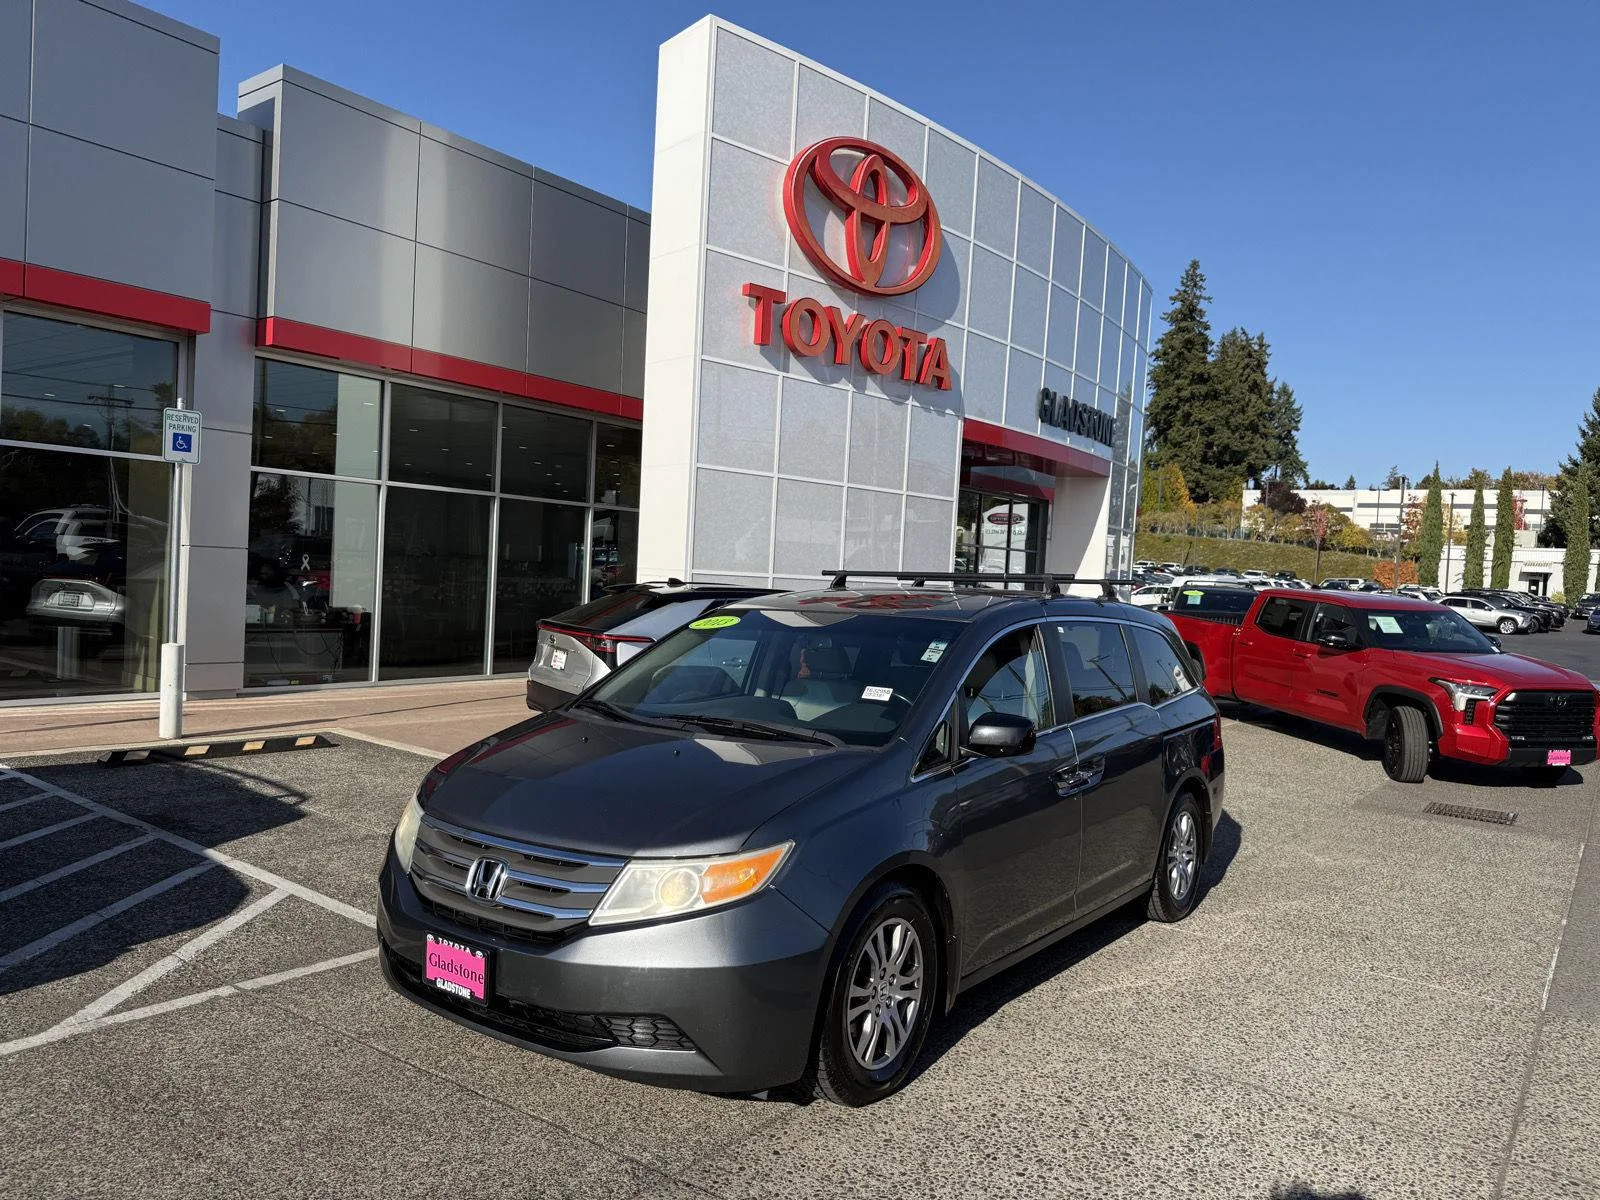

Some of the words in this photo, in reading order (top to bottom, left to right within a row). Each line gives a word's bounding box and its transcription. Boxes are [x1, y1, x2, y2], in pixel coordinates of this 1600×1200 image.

[742, 282, 952, 391] TOYOTA
[166, 413, 199, 424] RESERVED
[168, 422, 197, 433] PARKING
[437, 937, 471, 954] TOYOTA
[428, 952, 484, 985] Gladstone
[436, 977, 471, 999] GLADSTONE
